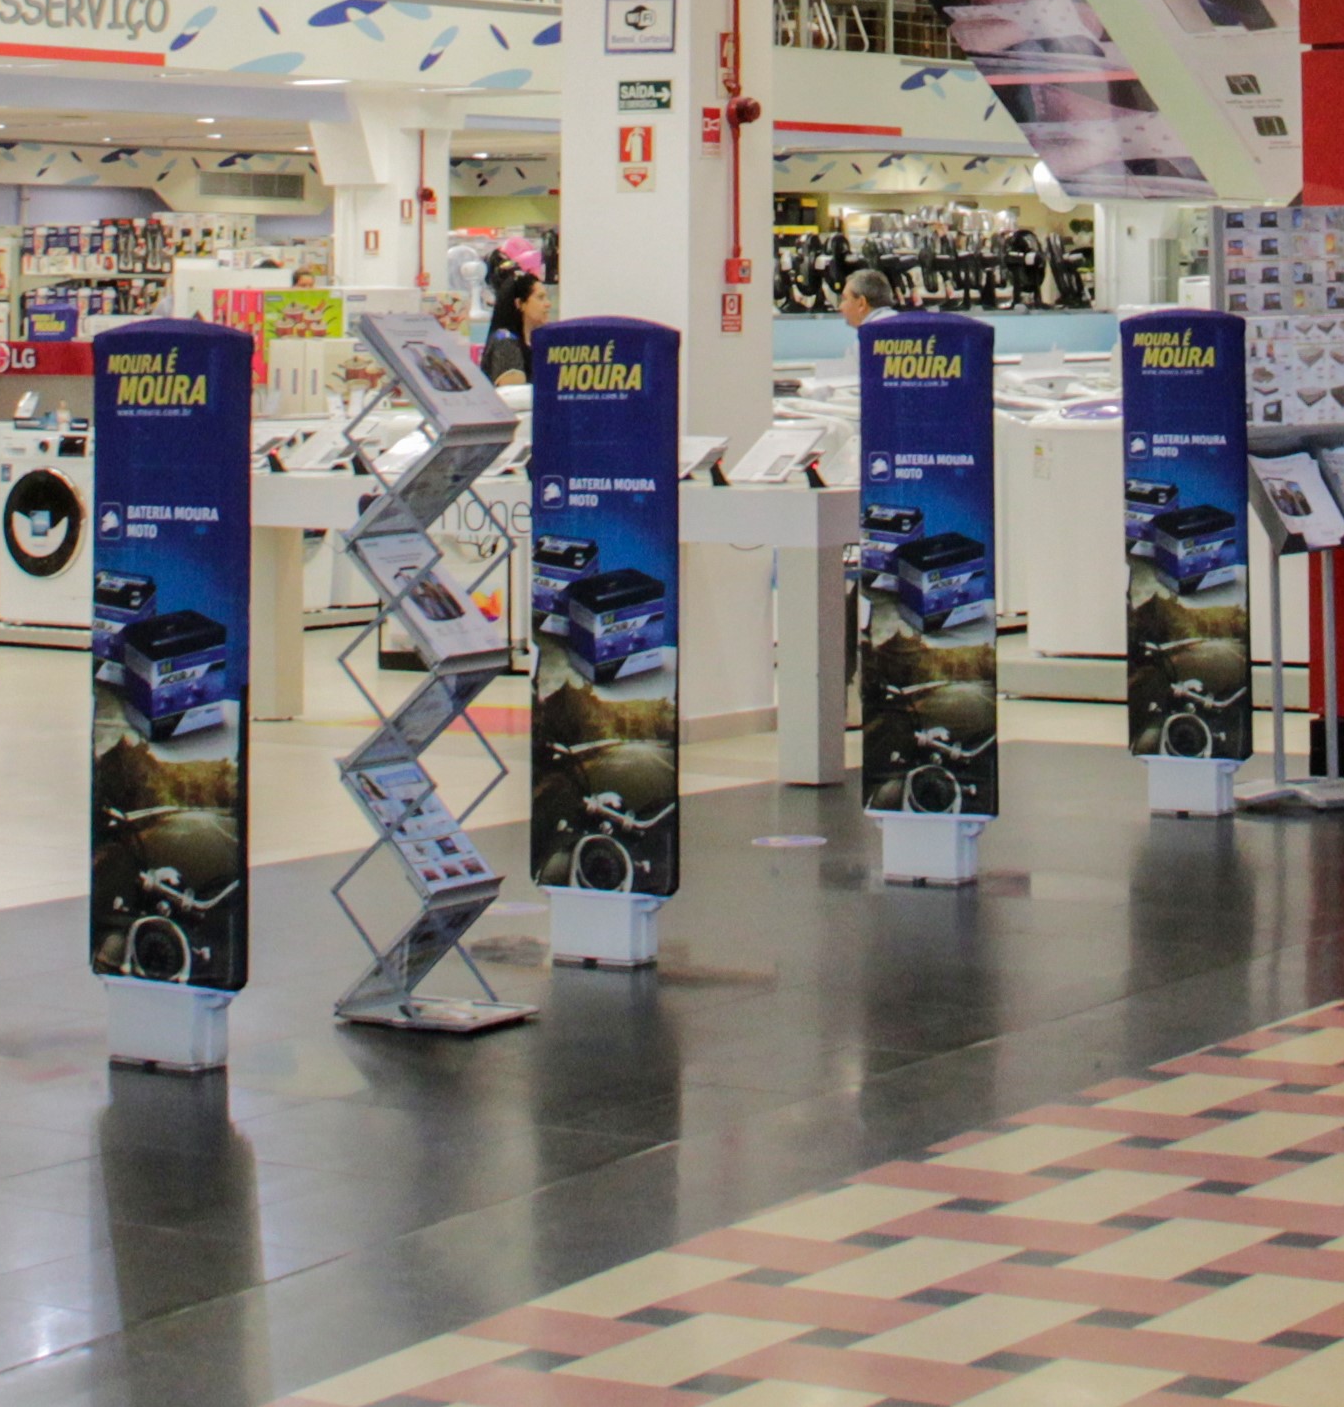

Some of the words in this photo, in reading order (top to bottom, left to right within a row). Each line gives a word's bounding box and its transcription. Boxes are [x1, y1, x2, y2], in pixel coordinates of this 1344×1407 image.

[620, 82, 656, 100] SAÍDA
[873, 339, 922, 355] MOURA
[926, 334, 937, 355] É
[1133, 332, 1179, 347] MOURA
[1182, 328, 1193, 346] É
[11, 348, 36, 369] LG
[108, 354, 162, 374] MOURA
[165, 347, 178, 374] É
[547, 345, 599, 364] MOURA
[603, 339, 615, 362] É
[1142, 346, 1216, 369] MOURA
[557, 363, 642, 391] MOURA
[883, 355, 961, 380] MOURA
[117, 374, 207, 406] MOURA
[894, 454, 935, 466] BATERIA
[936, 454, 975, 466] MOURA
[1152, 446, 1179, 458] MOTO
[894, 468, 923, 480] MOTO
[568, 477, 612, 491] BATERIA
[614, 478, 656, 492] MOURA
[568, 494, 599, 507] MOTO
[127, 505, 172, 520] BATERIA
[174, 506, 219, 521] MOURA
[126, 524, 158, 538] MOTO
